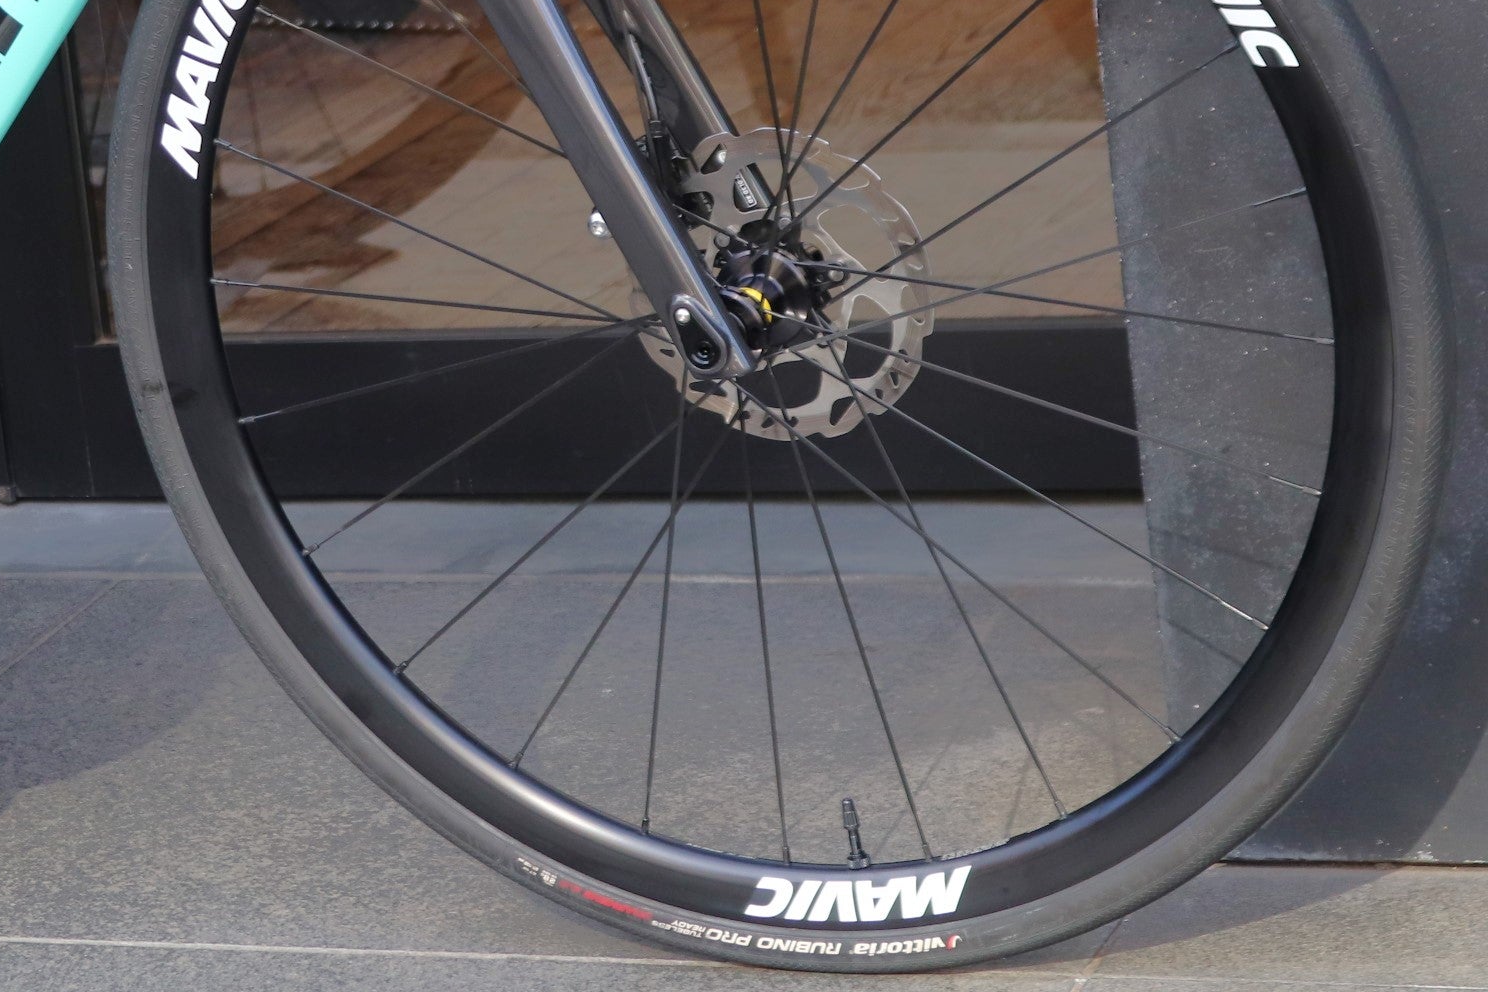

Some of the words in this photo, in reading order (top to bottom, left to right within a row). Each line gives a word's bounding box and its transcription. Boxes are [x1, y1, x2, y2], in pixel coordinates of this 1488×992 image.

[744, 865, 973, 923] MAVIC
[651, 919, 703, 939] TUBELESS
[670, 919, 706, 933] READY
[705, 928, 754, 947] PRO
[757, 937, 843, 955] RUBINO
[854, 934, 946, 957] vittoria
